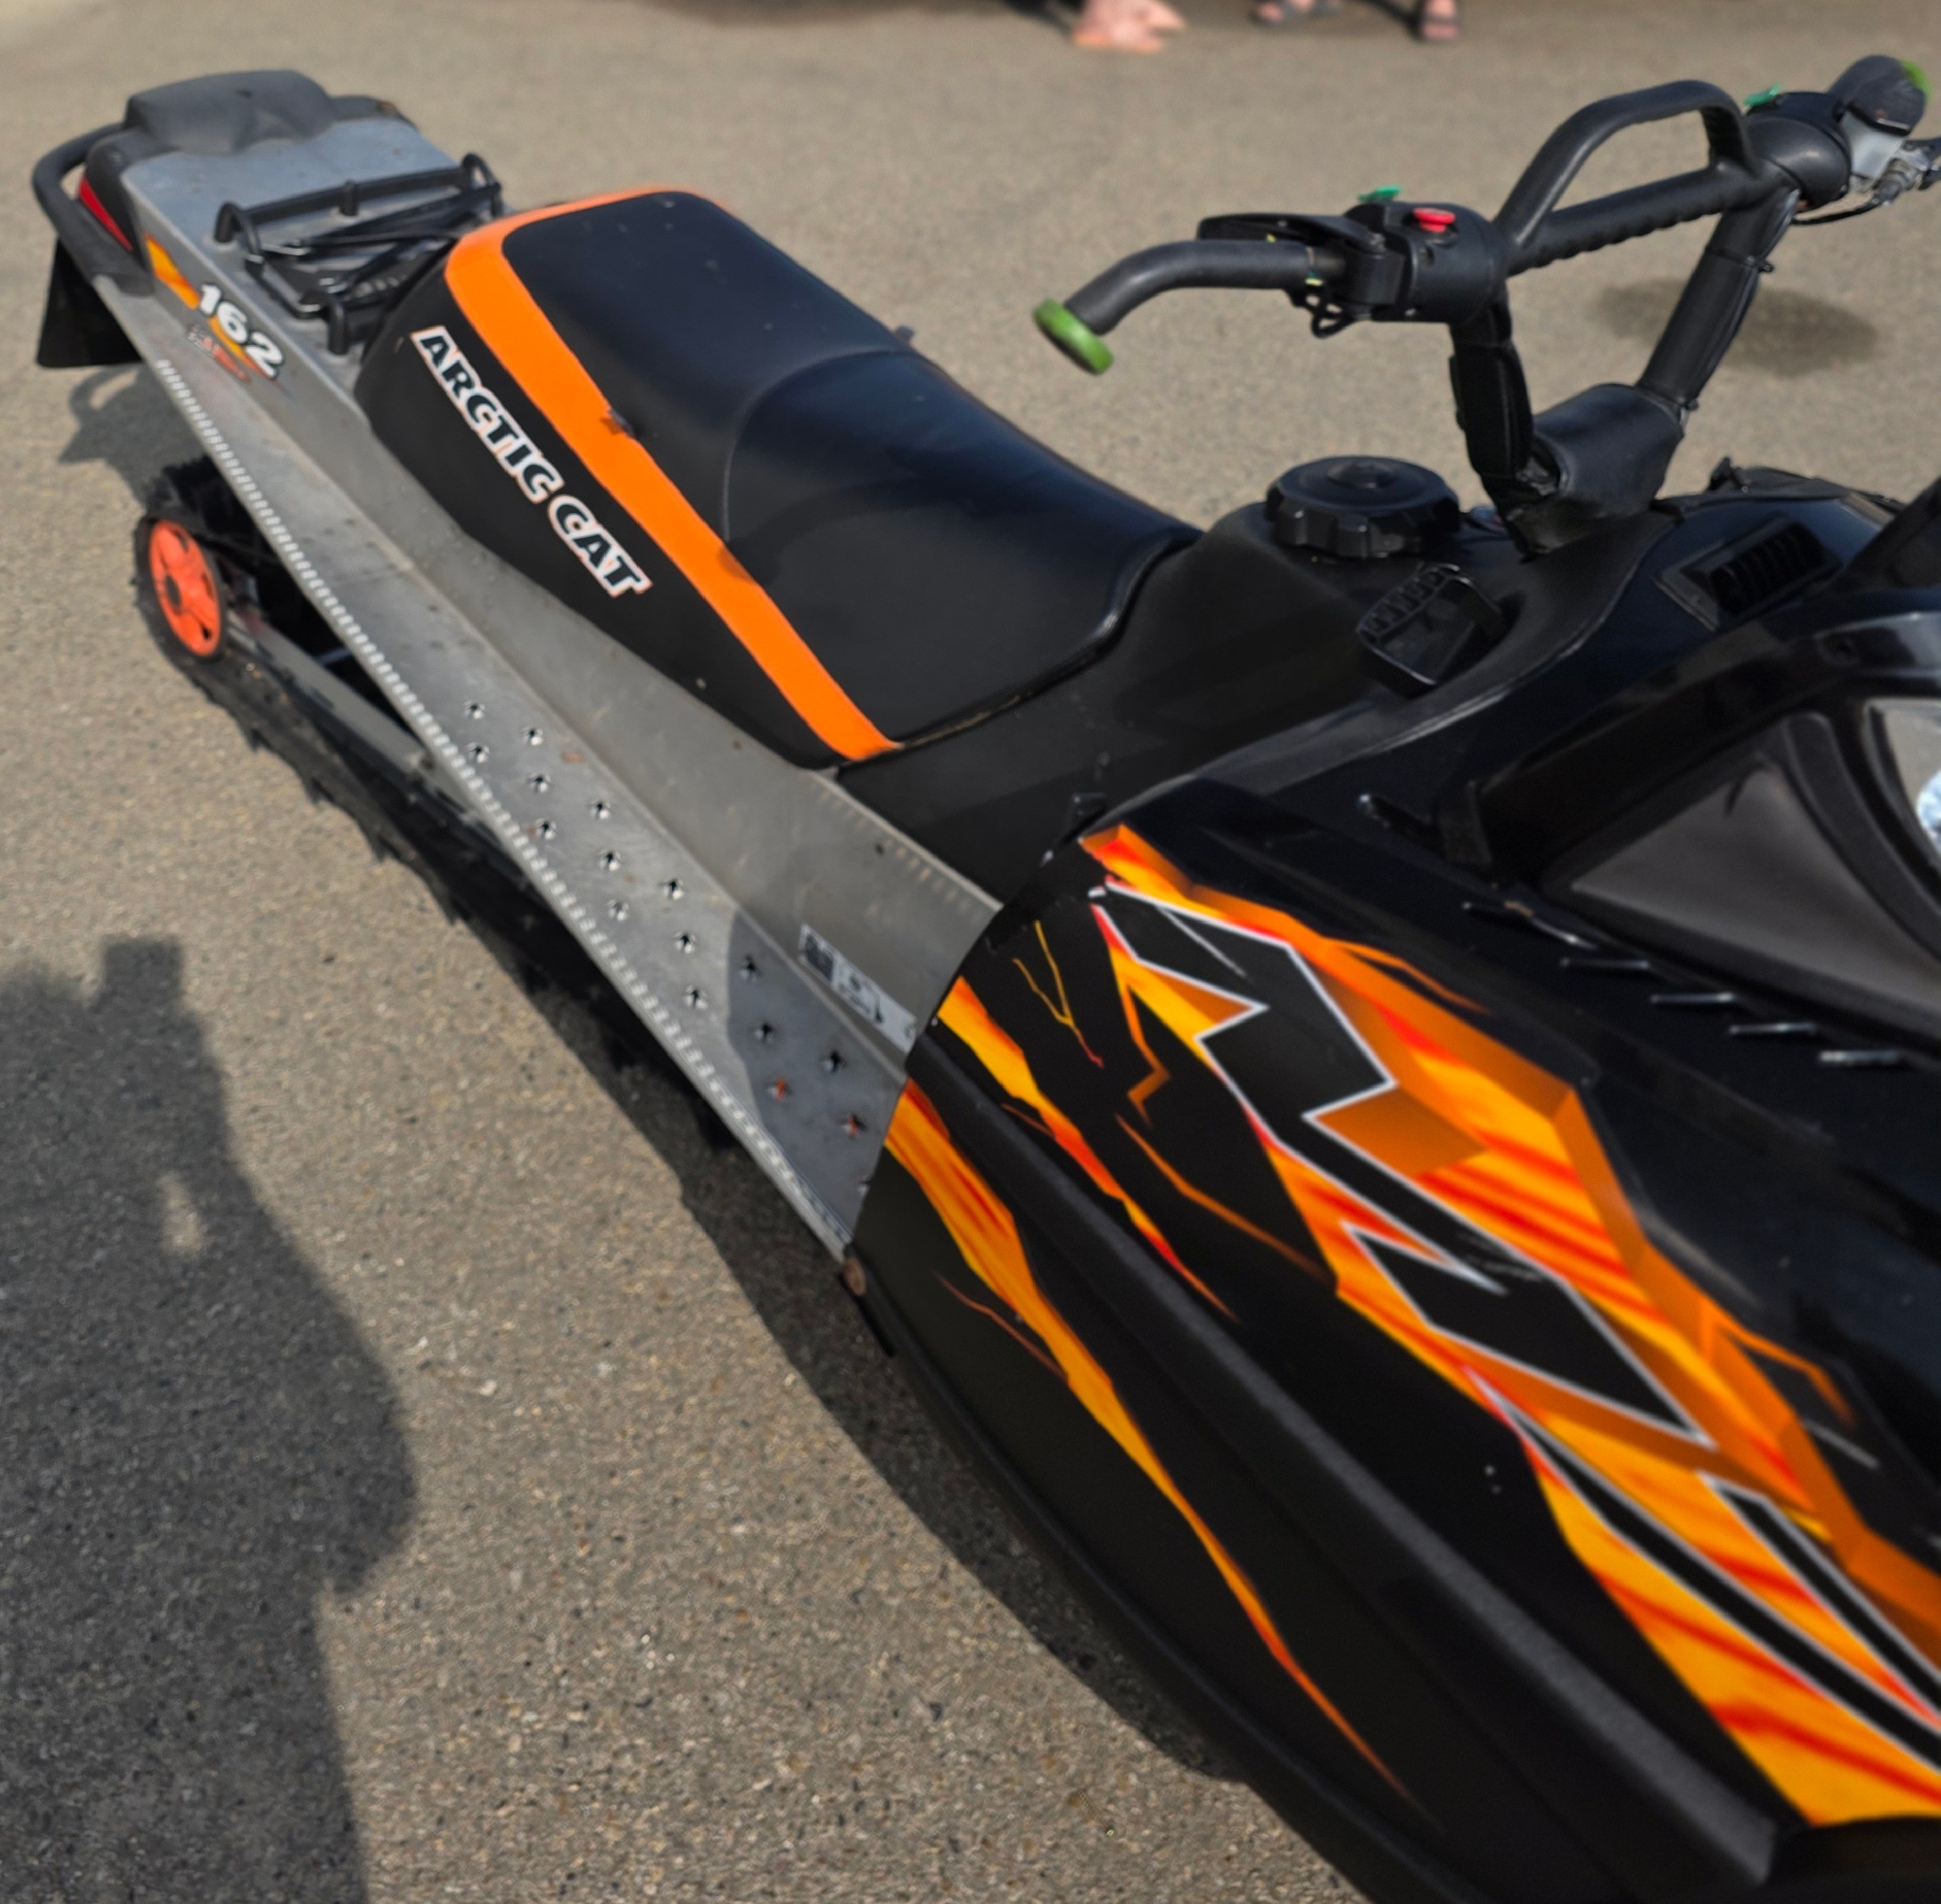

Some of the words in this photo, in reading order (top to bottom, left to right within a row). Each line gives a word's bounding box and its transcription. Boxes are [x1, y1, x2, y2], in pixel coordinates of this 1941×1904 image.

[199, 283, 283, 378] 162
[412, 326, 563, 502] ARCTIC
[550, 496, 651, 595] CAT
